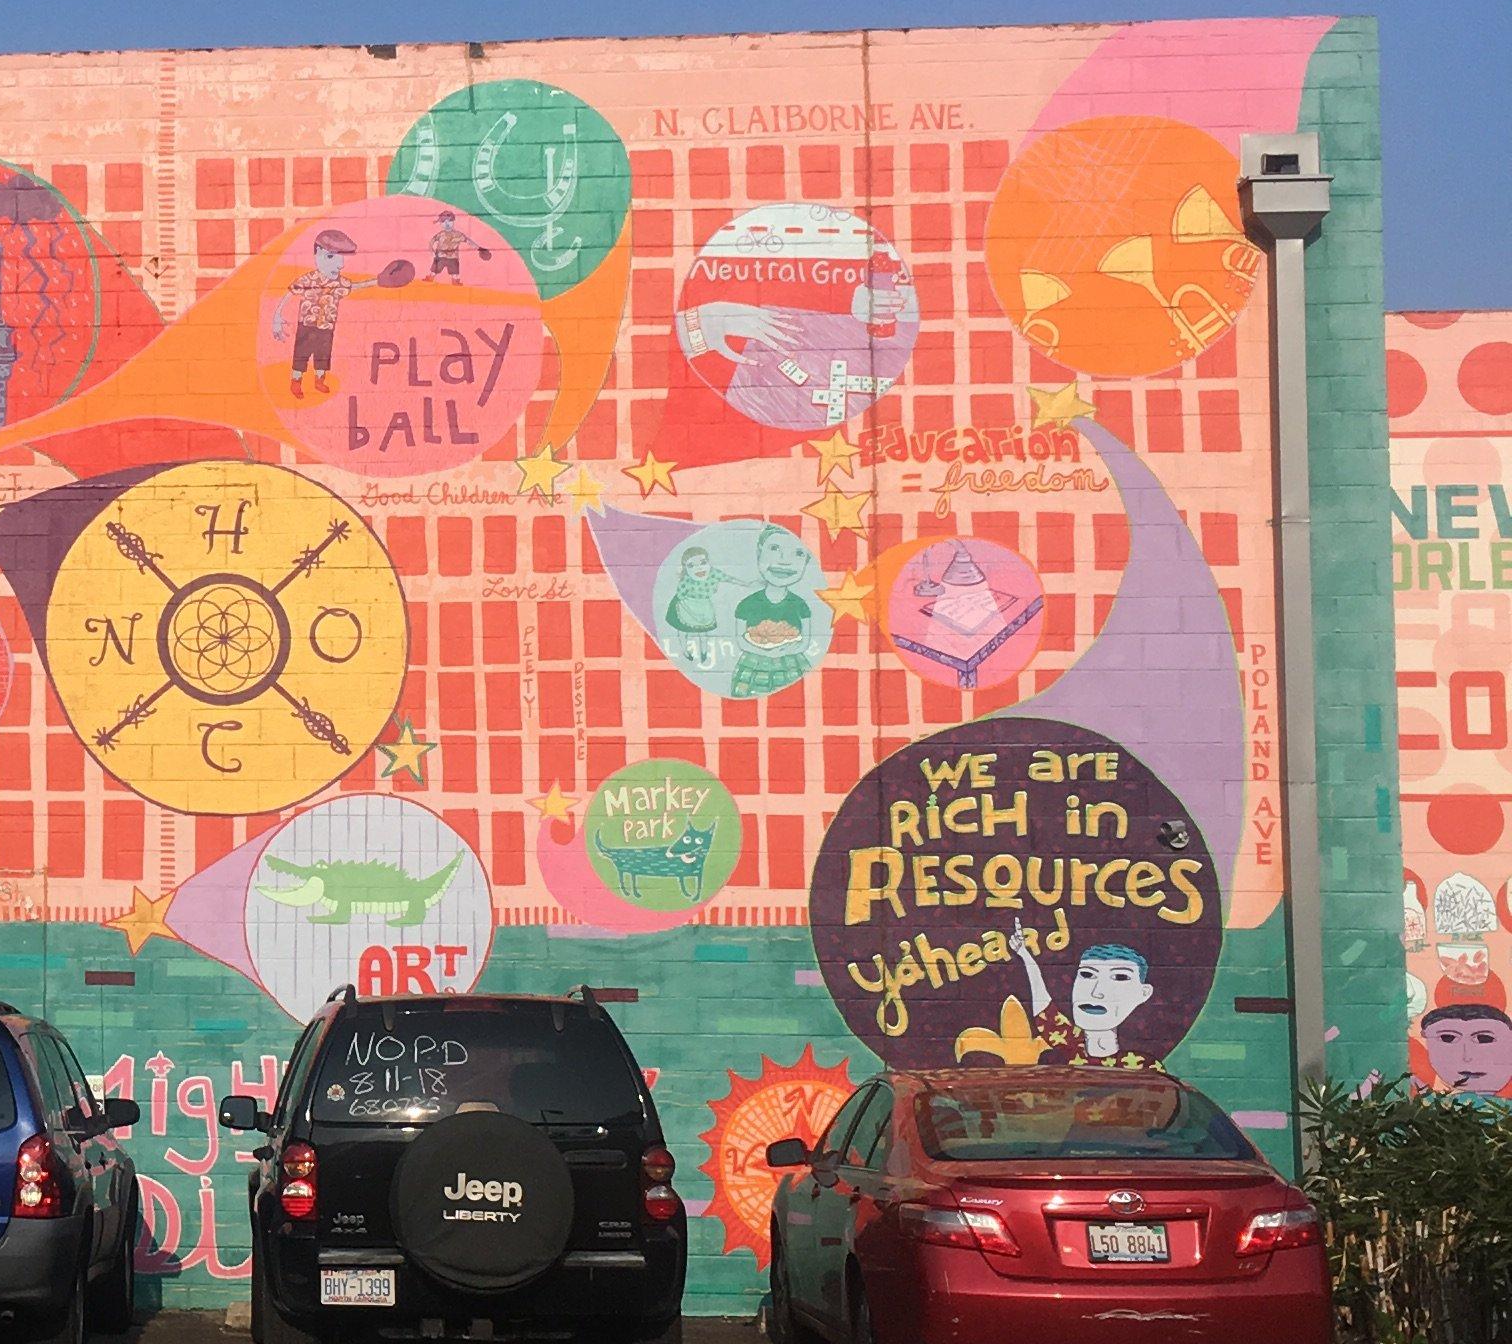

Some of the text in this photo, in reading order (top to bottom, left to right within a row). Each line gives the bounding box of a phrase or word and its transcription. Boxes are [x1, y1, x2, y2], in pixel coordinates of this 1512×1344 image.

[702, 102, 897, 135] CLAIBORNE
[910, 103, 974, 131] AVE.
[690, 258, 806, 284] Neutral
[360, 482, 421, 507] Good
[427, 482, 516, 505] Children
[929, 462, 1110, 520] freedom
[482, 577, 538, 599] Love
[522, 626, 536, 719] PIETY
[573, 662, 586, 761] DESIRE
[1249, 644, 1277, 865] POLAND AVE
[920, 752, 997, 793] WE
[1066, 794, 1128, 839] in
[444, 1172, 523, 1207] Jeep
[332, 1212, 365, 1226] Jeep
[442, 1210, 522, 1223] LIBERTY
[1127, 1235, 1167, 1254] 8841
[324, 1277, 391, 1297] BHY-1399
